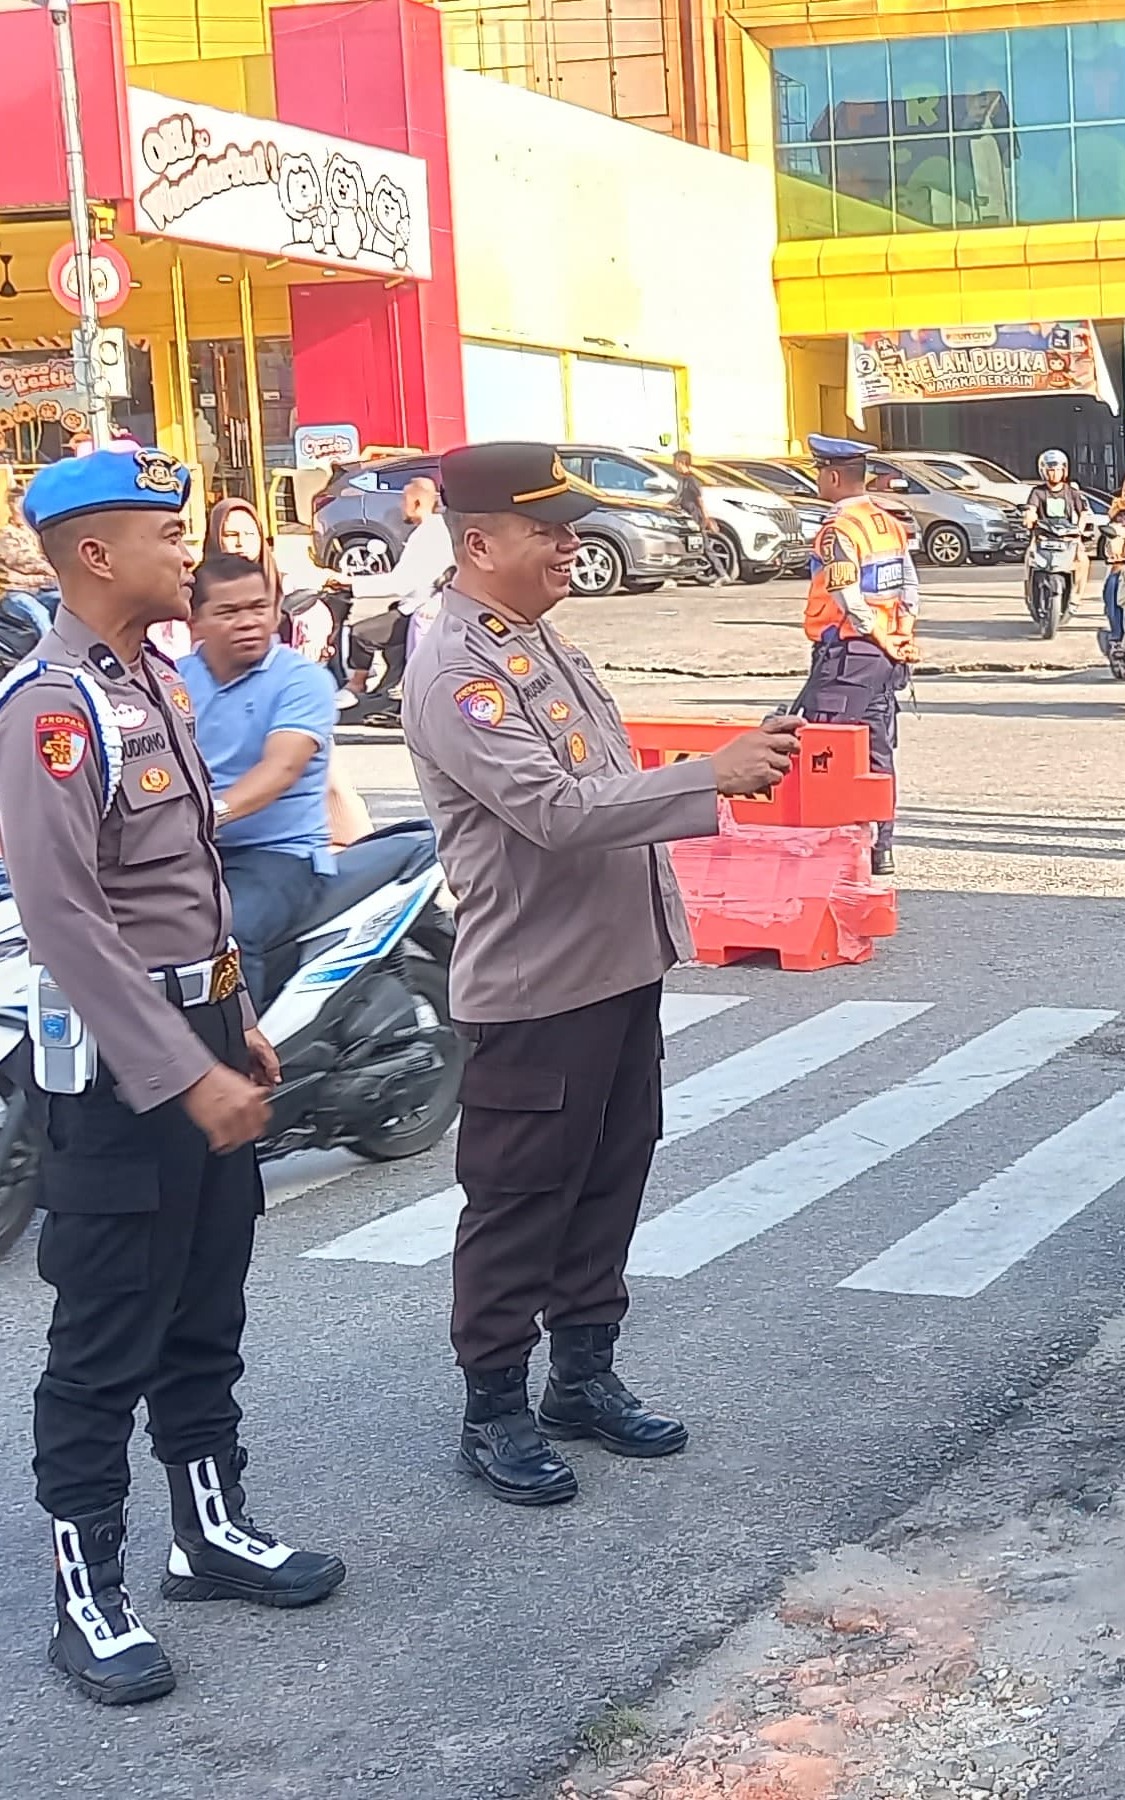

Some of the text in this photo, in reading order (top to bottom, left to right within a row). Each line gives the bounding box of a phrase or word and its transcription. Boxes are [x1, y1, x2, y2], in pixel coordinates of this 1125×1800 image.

[906, 349, 1047, 383] TELAH DIBUKA
[924, 374, 1034, 393] WAHANA BERMAIN
